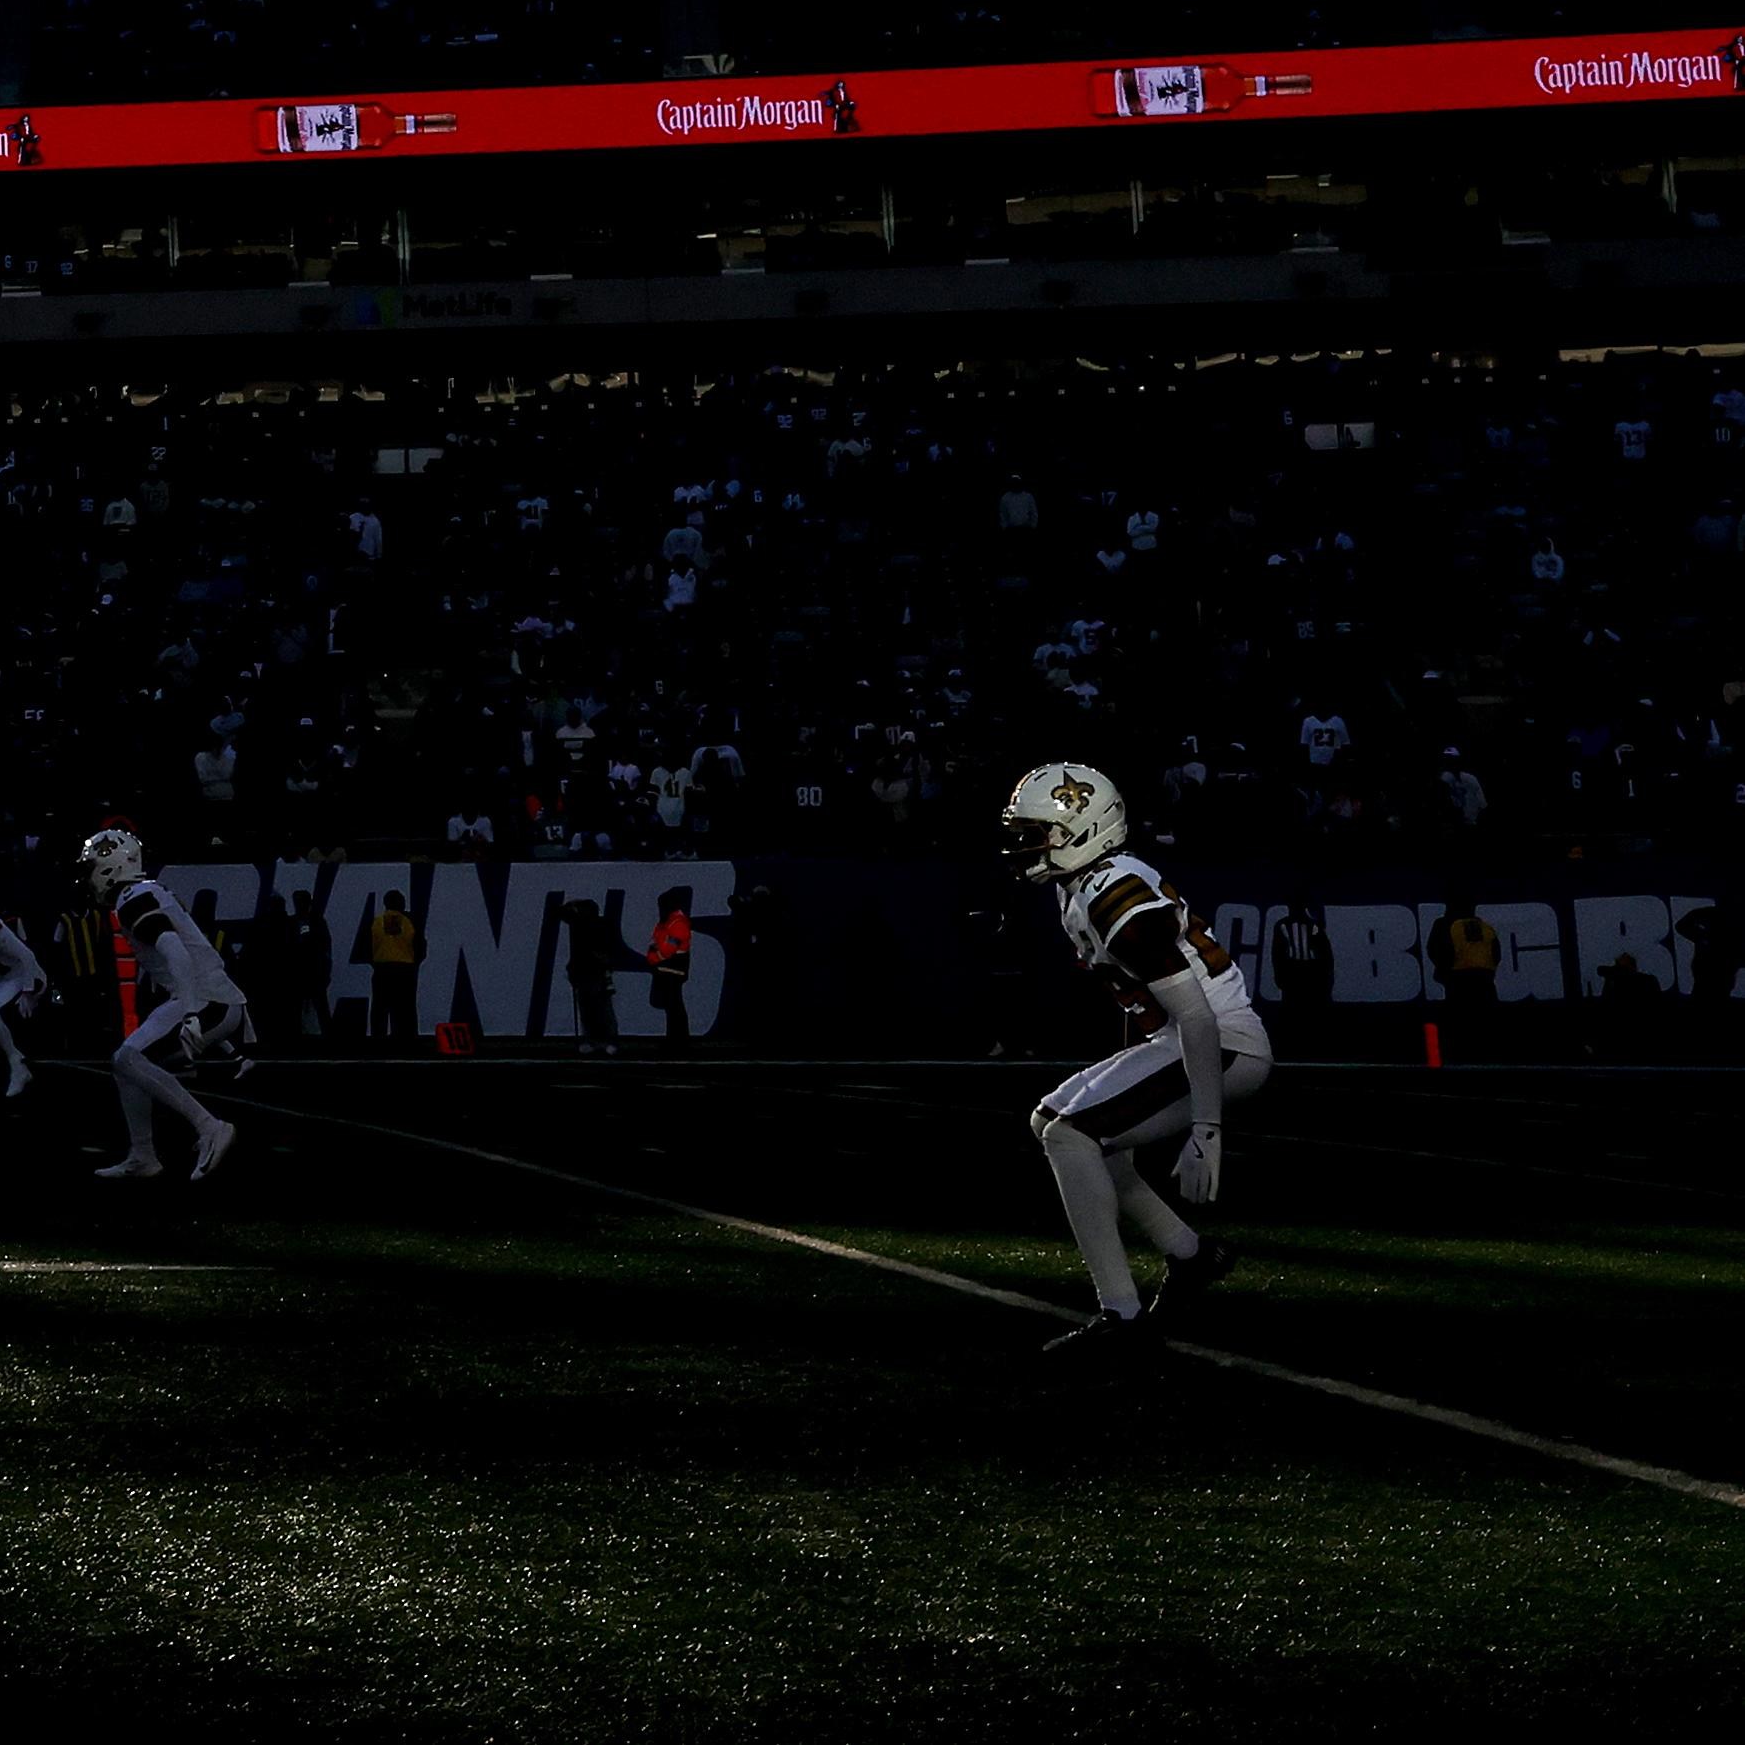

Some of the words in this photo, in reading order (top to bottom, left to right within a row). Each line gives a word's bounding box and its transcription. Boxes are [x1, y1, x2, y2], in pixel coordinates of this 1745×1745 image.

[1534, 54, 1623, 93] Captain
[1624, 52, 1721, 87] Morgan
[657, 97, 736, 135] Captain
[737, 96, 822, 131] Morgan
[403, 291, 511, 318] MetLife
